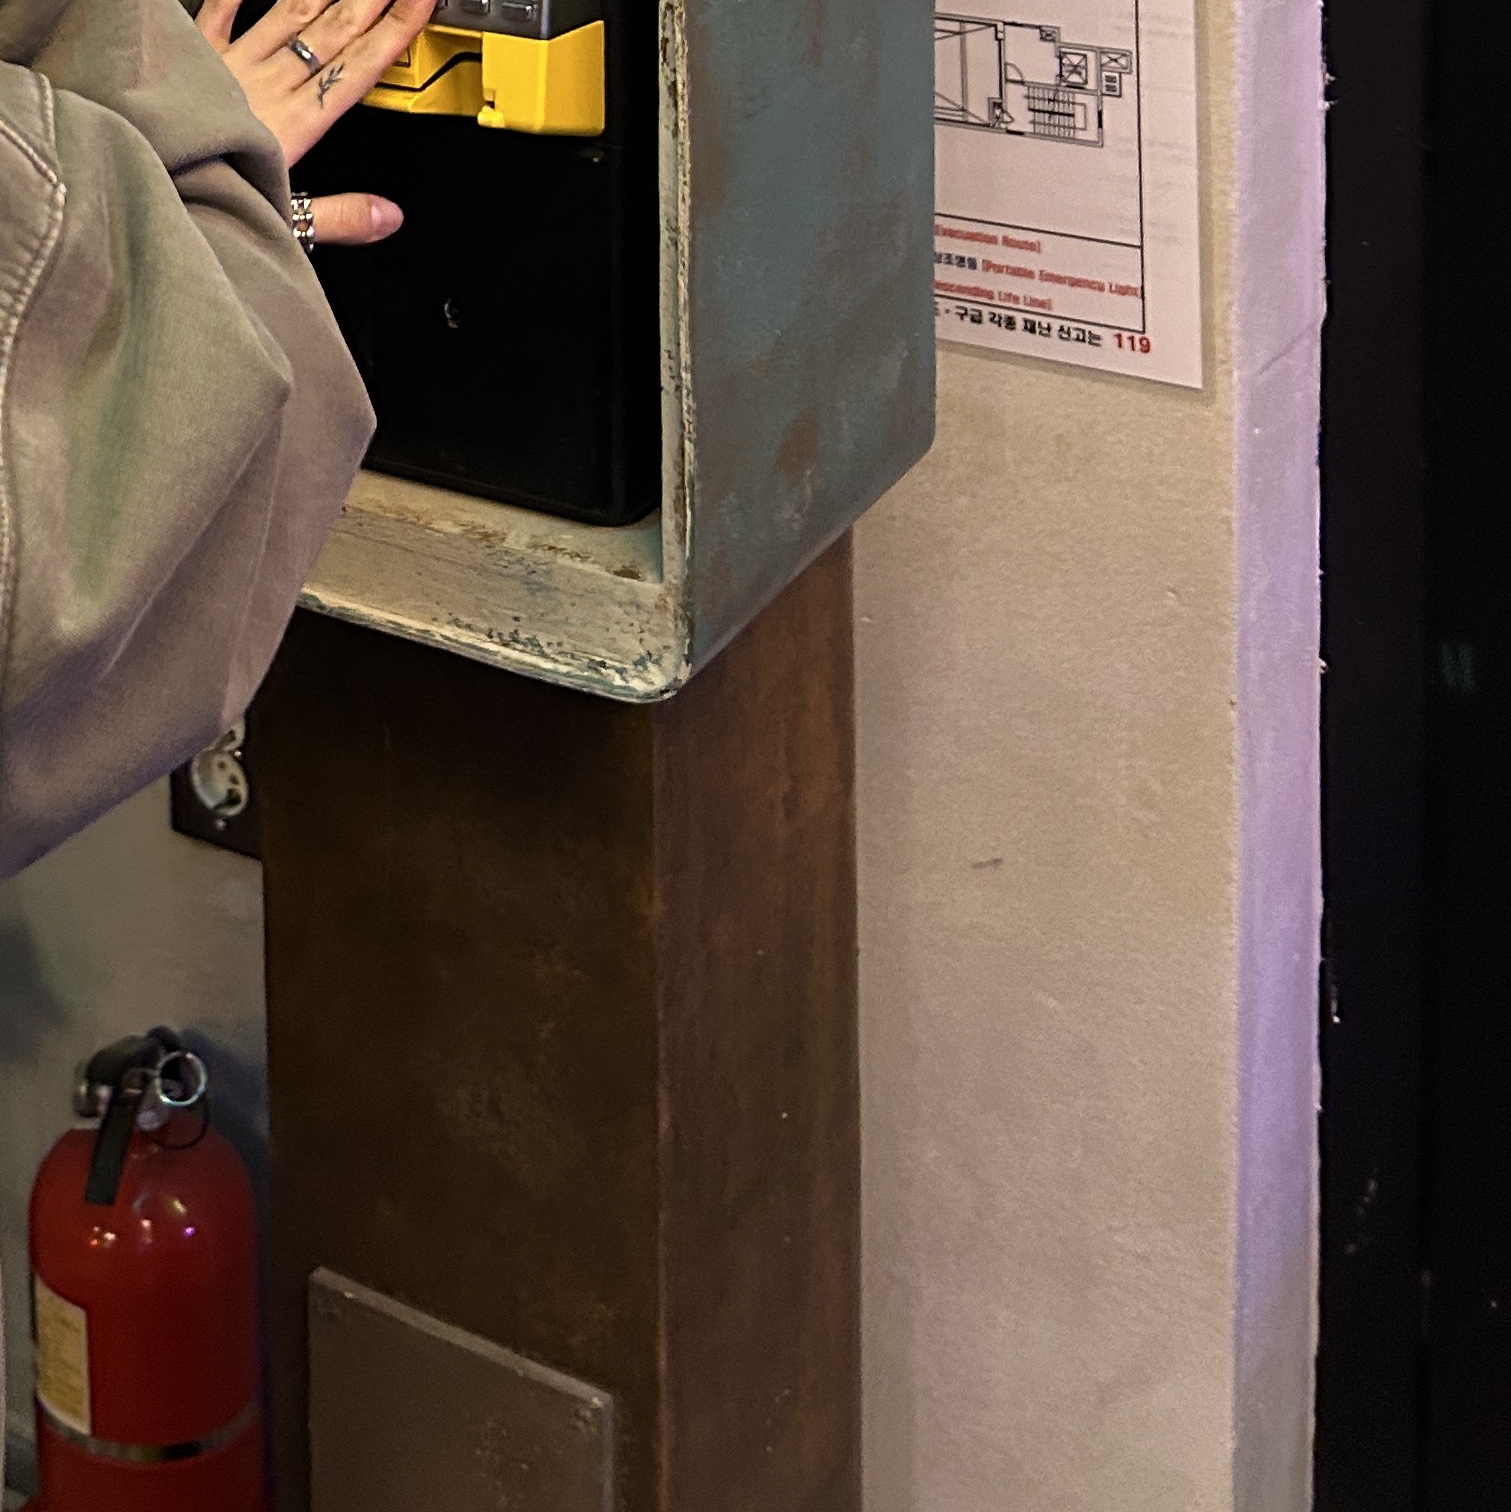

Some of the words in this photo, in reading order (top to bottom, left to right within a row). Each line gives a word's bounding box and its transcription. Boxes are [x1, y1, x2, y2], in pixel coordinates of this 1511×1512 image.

[989, 311, 1017, 331] 각종
[1022, 317, 1052, 338] 재난
[1057, 324, 1102, 348] 신고는
[1113, 332, 1152, 354] 119
